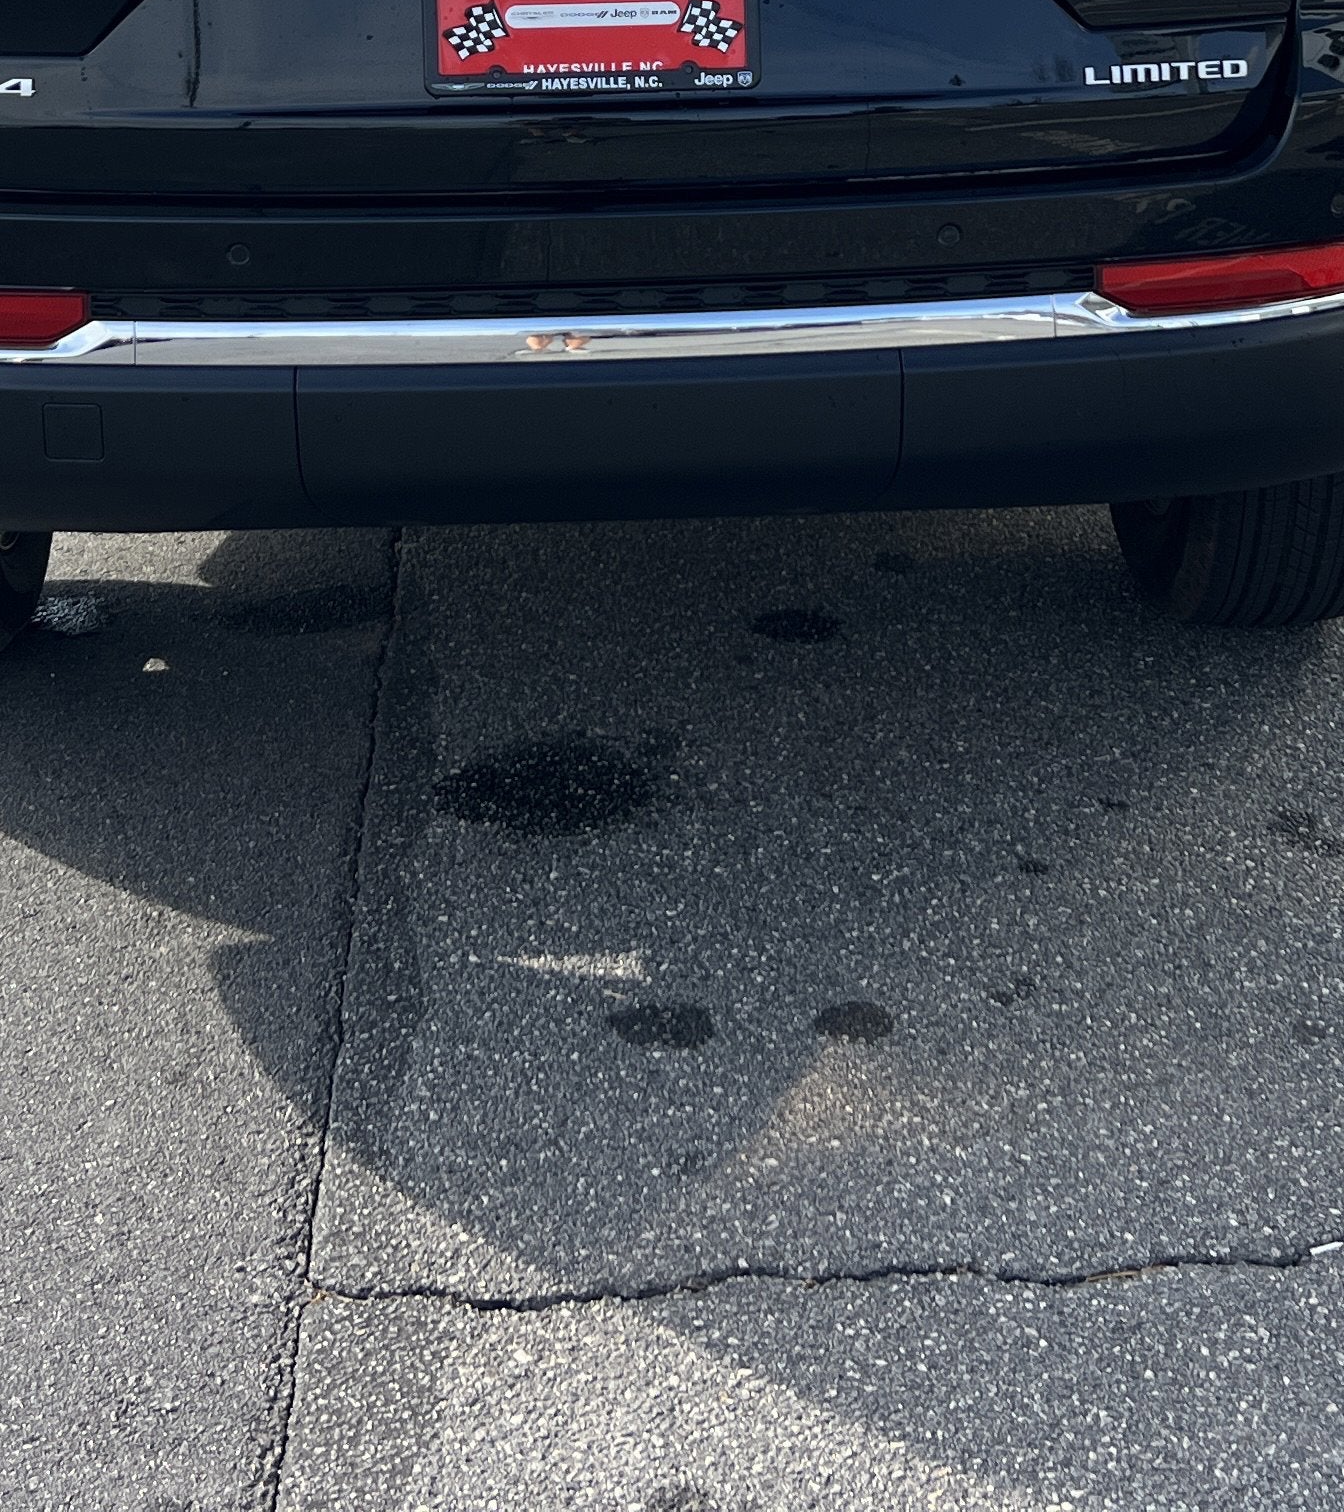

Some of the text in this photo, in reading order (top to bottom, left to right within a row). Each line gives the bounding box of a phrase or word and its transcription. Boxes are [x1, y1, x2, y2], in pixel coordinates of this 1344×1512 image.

[609, 8, 638, 20] Jeep
[541, 76, 632, 91] HAYESVILLE,
[634, 75, 663, 88] N.C.
[693, 71, 733, 88] Jeep
[1084, 59, 1249, 86] LIMITED
